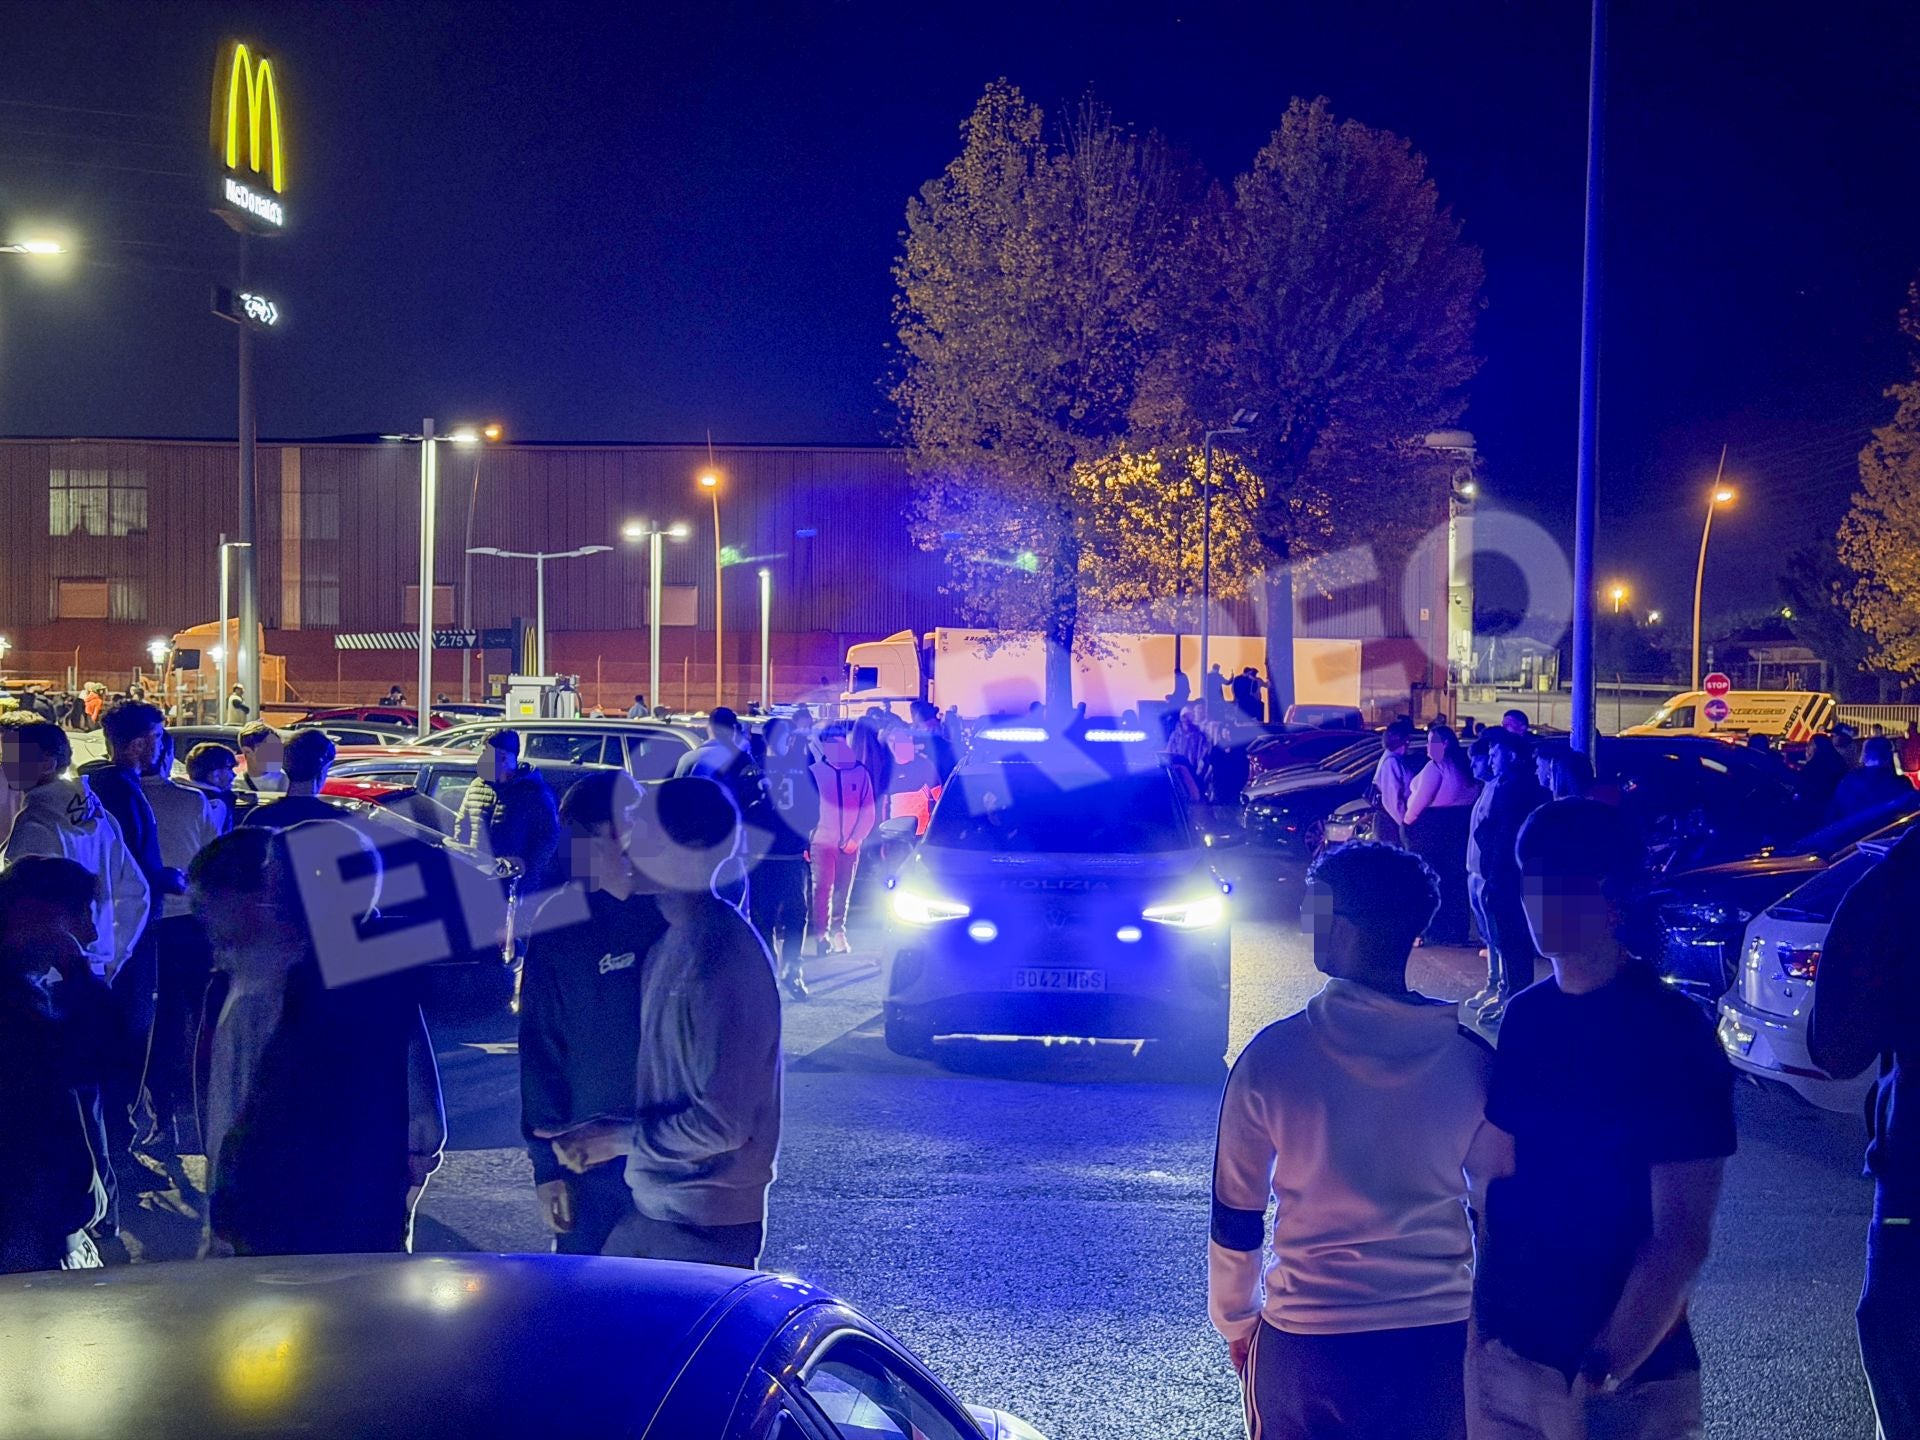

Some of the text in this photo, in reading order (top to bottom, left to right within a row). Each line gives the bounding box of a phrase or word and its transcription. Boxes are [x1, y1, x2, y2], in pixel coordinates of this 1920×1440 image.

[225, 178, 283, 226] McDonald's
[440, 635, 463, 647] 2.75
[1706, 681, 1729, 690] STOP
